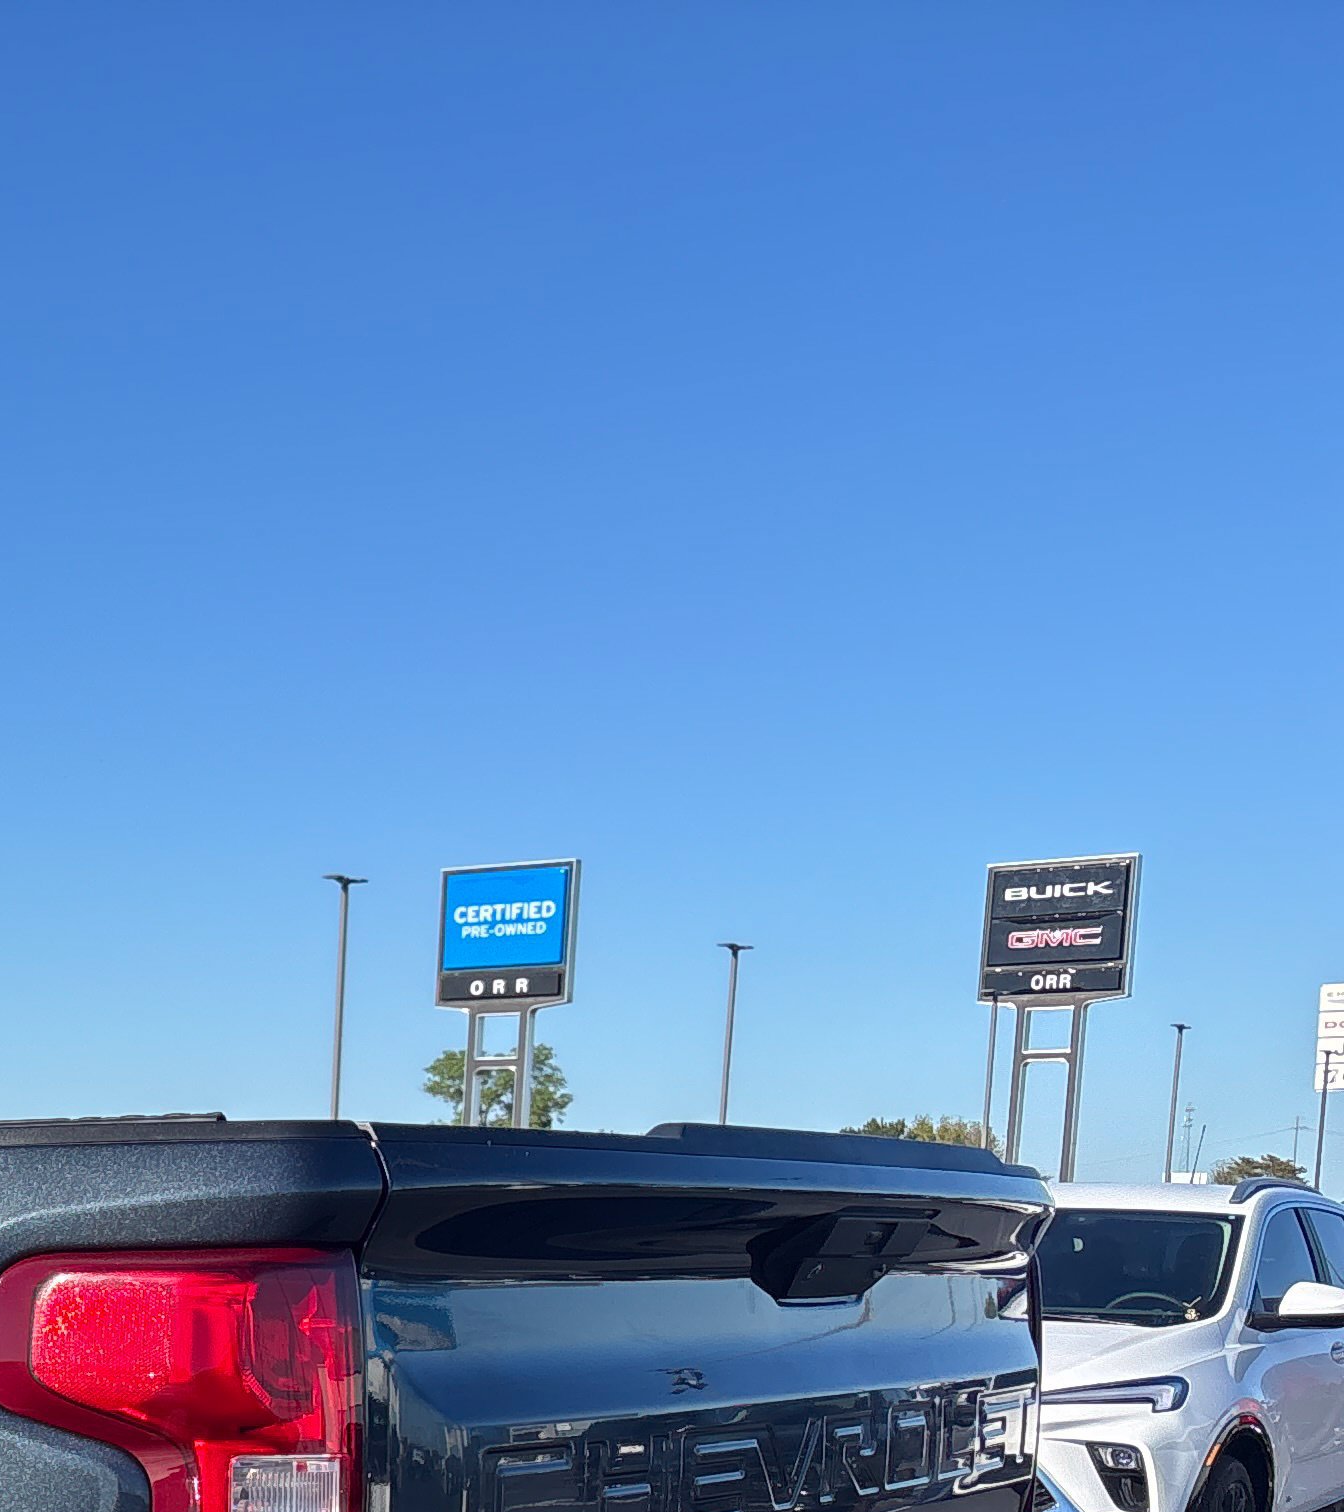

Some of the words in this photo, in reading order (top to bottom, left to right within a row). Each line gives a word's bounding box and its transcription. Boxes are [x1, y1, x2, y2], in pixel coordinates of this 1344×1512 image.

[1004, 880, 1114, 902] BUICK
[453, 900, 557, 924] CERTIFIED
[461, 921, 547, 939] PRE-OWNED
[1007, 925, 1104, 949] GMC
[1030, 972, 1072, 991] ORR
